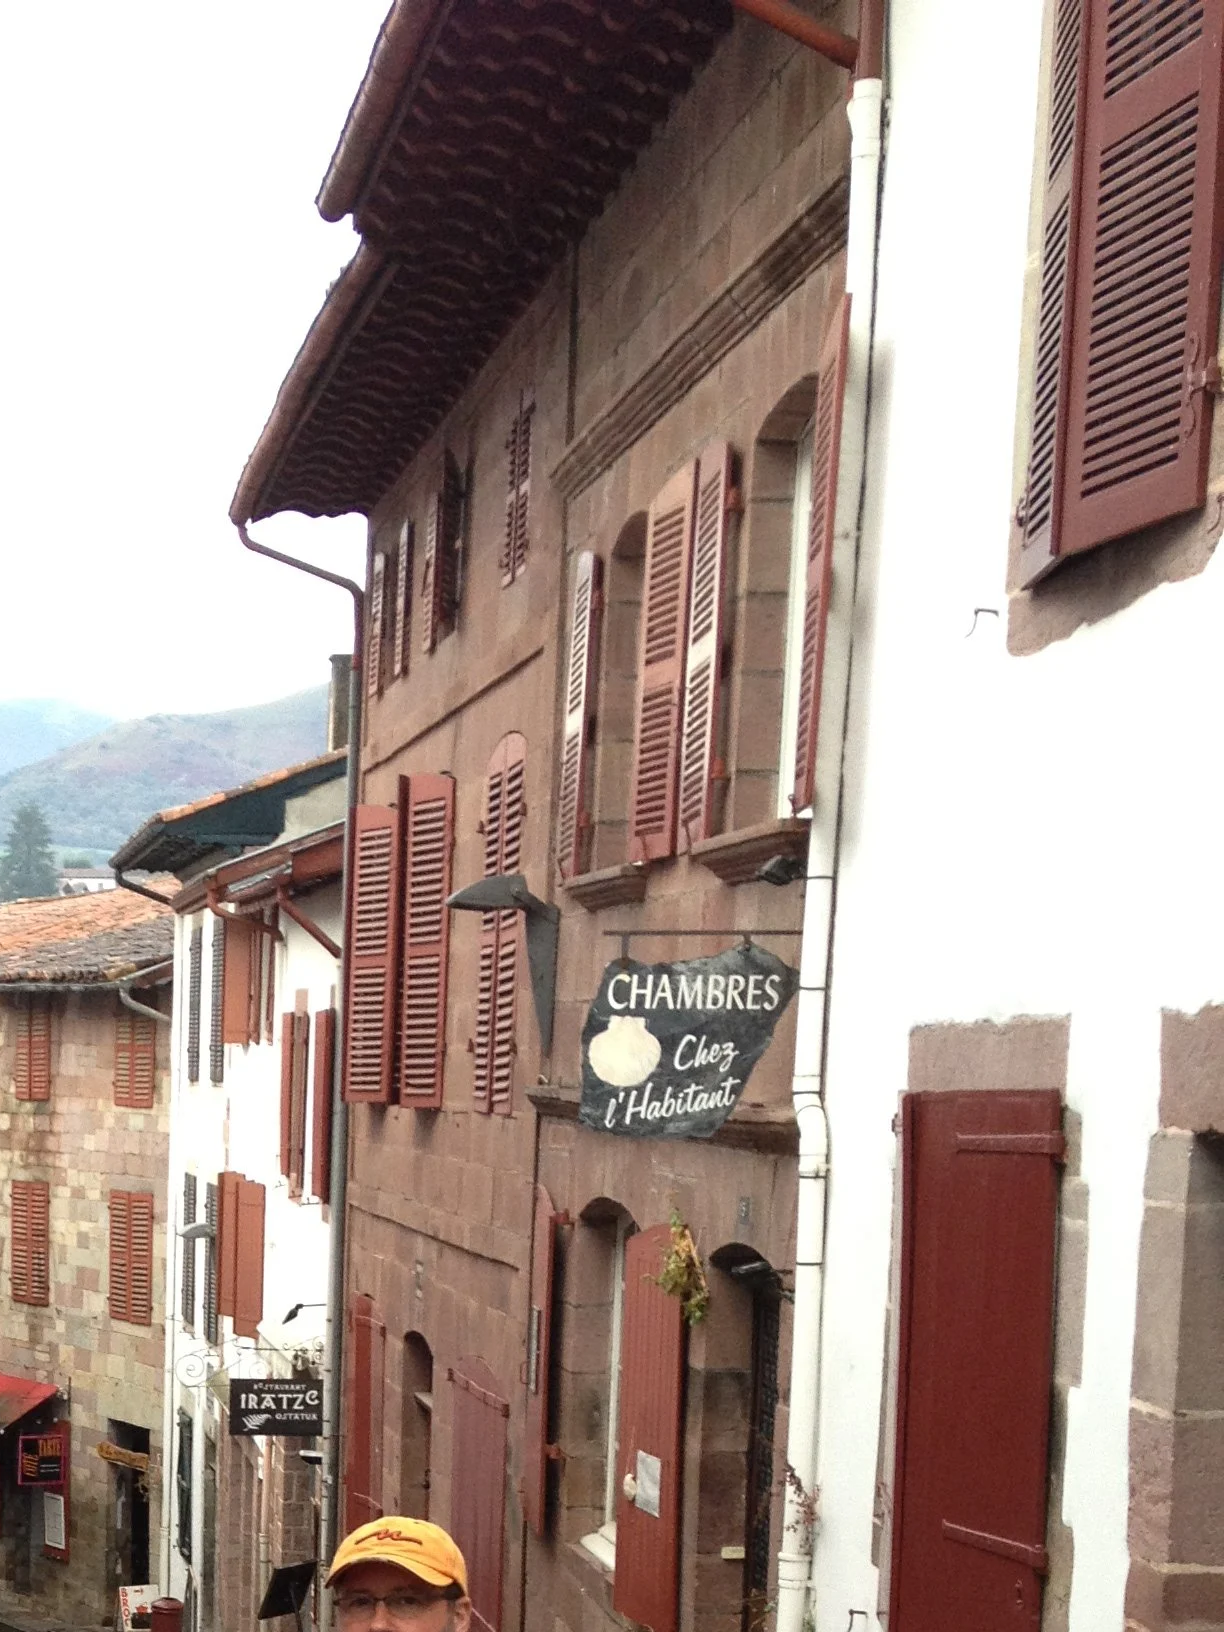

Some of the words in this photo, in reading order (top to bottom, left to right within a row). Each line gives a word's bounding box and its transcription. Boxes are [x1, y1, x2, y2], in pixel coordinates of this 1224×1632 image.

[607, 973, 782, 1011] CHAMBRES
[673, 1033, 739, 1072] Chez
[604, 1079, 742, 1129] l'Habitant
[240, 1390, 321, 1410] IRATZE
[253, 1382, 307, 1391] RESTAURANT
